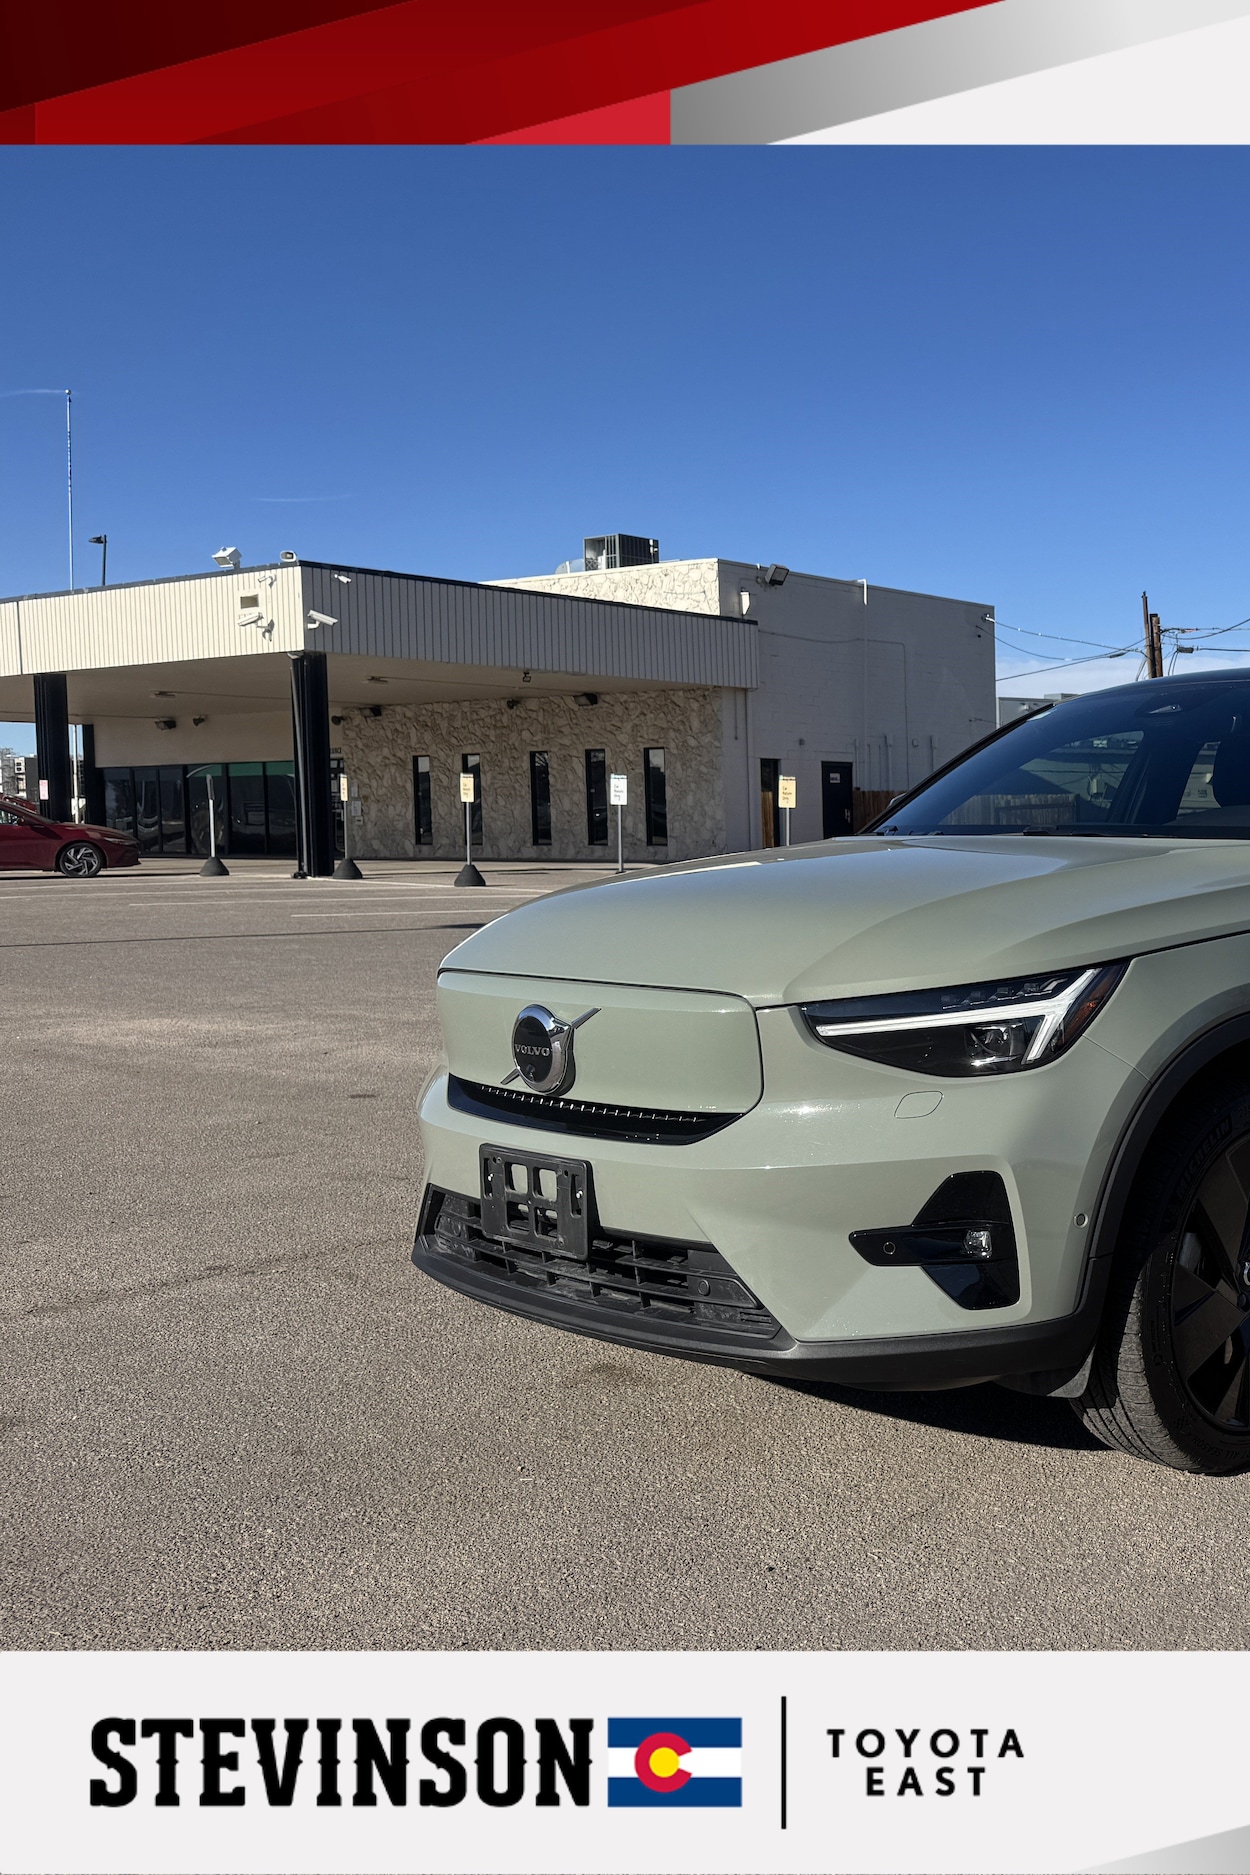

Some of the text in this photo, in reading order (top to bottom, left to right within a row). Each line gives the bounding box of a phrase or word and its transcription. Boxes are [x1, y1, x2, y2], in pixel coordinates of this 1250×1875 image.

[514, 1043, 551, 1058] VOLVO
[1175, 1117, 1232, 1200] MICHELIN
[1191, 1436, 1223, 1458] SEASON
